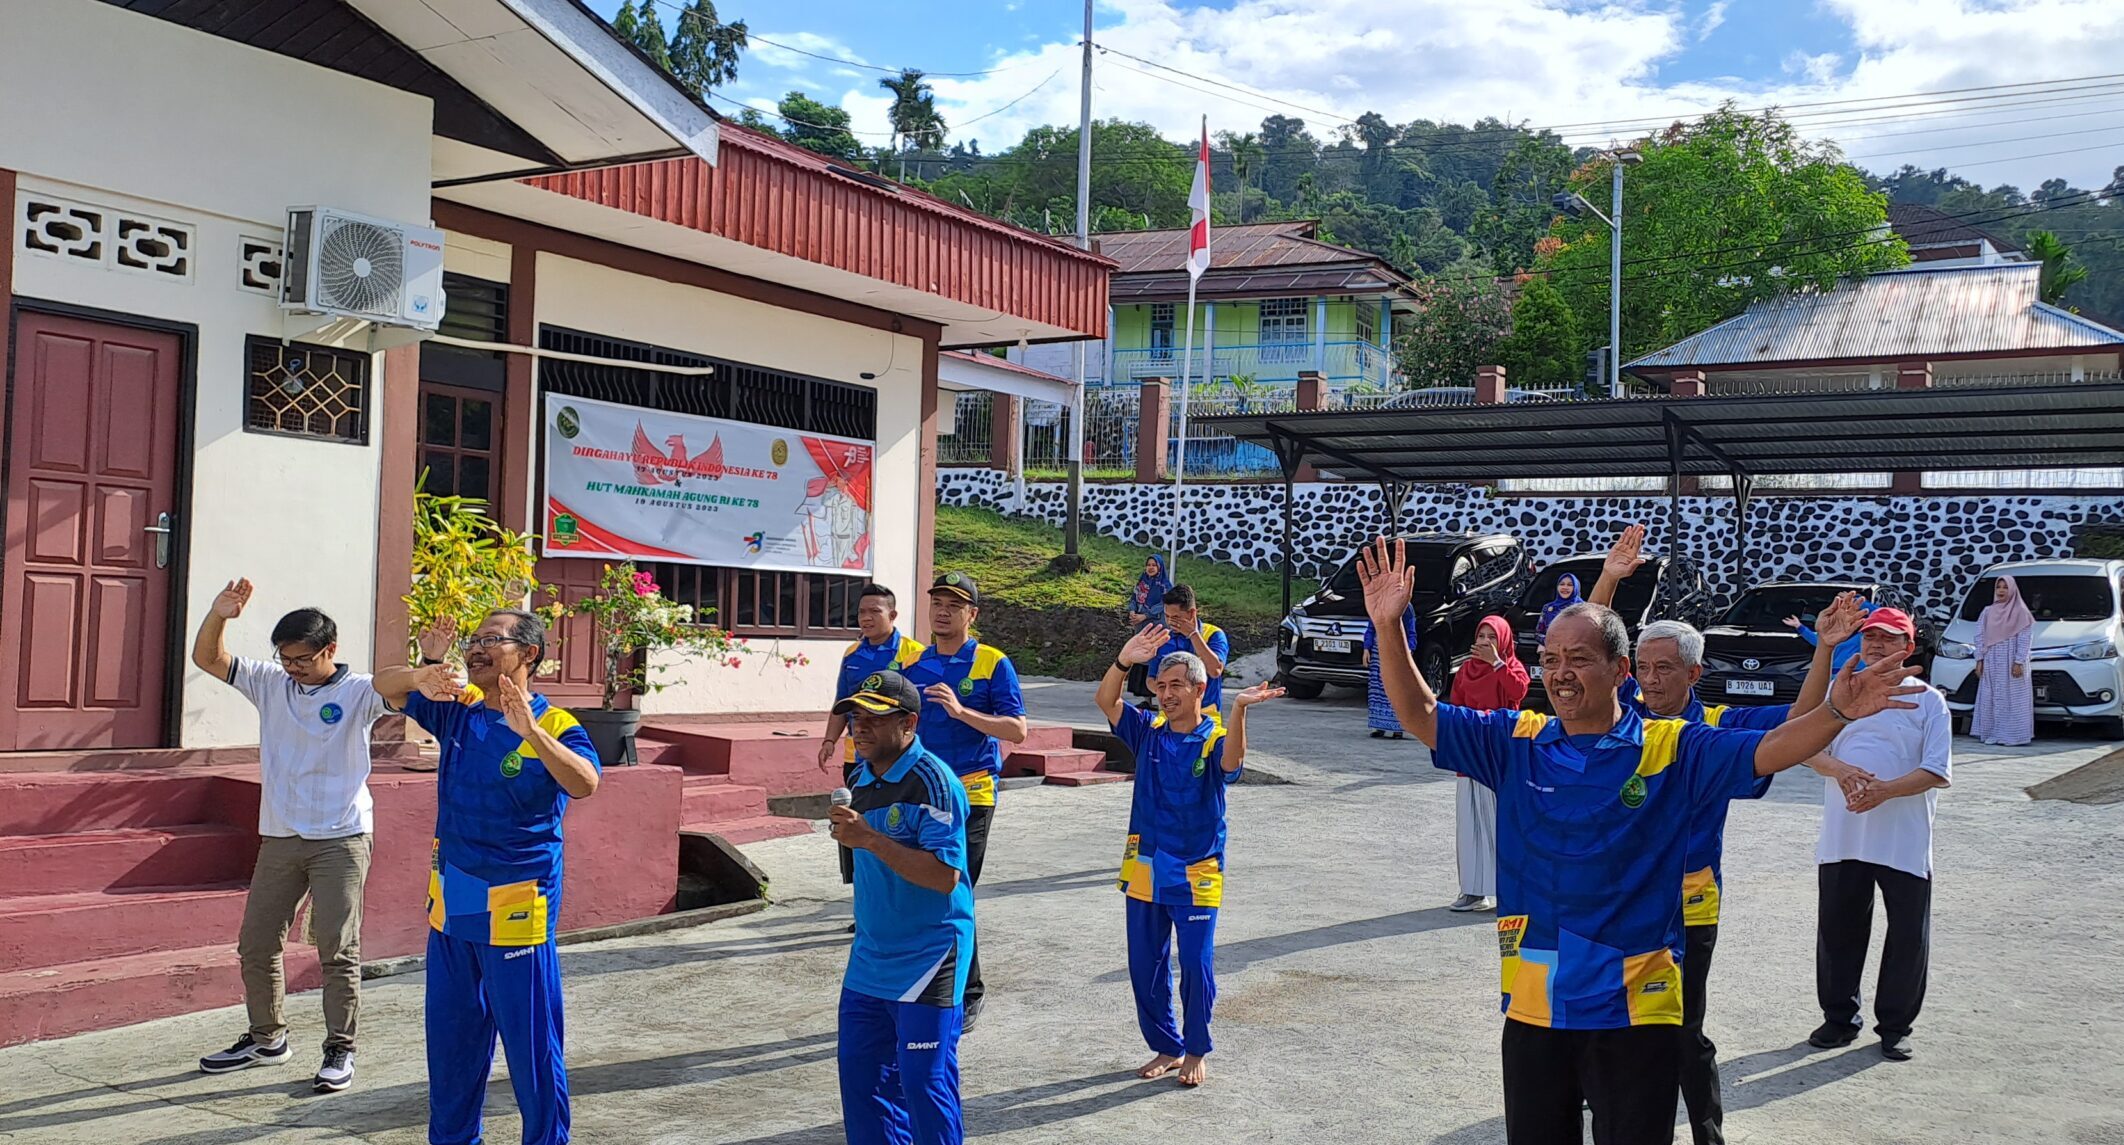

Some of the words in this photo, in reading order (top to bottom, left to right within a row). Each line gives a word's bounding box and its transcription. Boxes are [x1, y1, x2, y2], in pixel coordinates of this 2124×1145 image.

[410, 239, 441, 251] POLYTRON
[573, 446, 641, 463] DIRGAHAYU
[642, 455, 696, 471] REPUBLIK
[697, 463, 750, 478] INDONESIA
[751, 470, 765, 479] KE
[766, 471, 778, 480] 78
[650, 467, 692, 478] AGUSTUS
[696, 473, 719, 482] 2023
[674, 479, 682, 488] &
[586, 481, 612, 493] HUT
[613, 484, 681, 500] MAHKAMAH
[682, 491, 718, 504] AGUNG
[719, 495, 730, 505] RI
[731, 497, 745, 507] KE
[747, 499, 759, 508] 78
[649, 499, 692, 509] AGUSTUS
[695, 504, 719, 512] 2023
[1727, 680, 1733, 689] B
[1736, 681, 1755, 690] 1926
[1758, 682, 1773, 691] UAI
